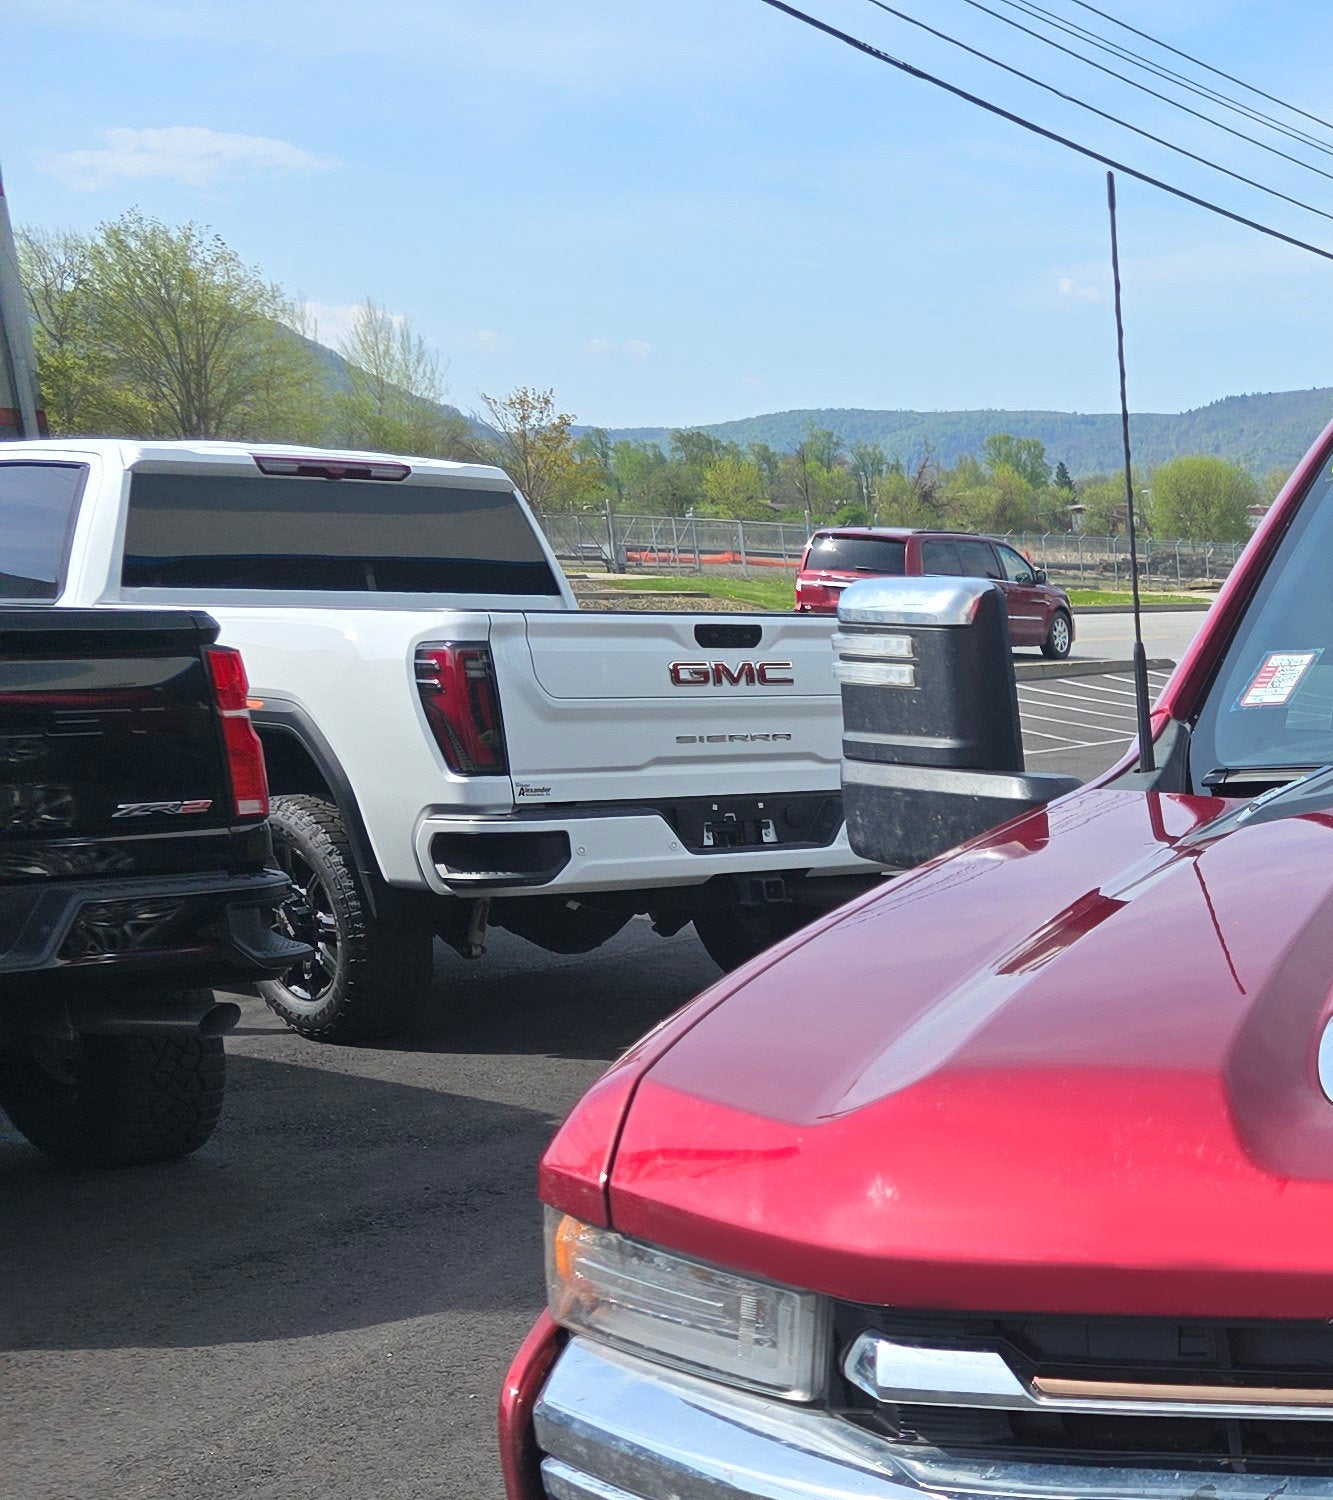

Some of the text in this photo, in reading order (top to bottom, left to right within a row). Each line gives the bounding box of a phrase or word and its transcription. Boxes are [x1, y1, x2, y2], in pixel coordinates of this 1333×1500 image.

[668, 660, 794, 687] GMC
[676, 732, 792, 744] SIERRA
[111, 799, 213, 818] ZR2
